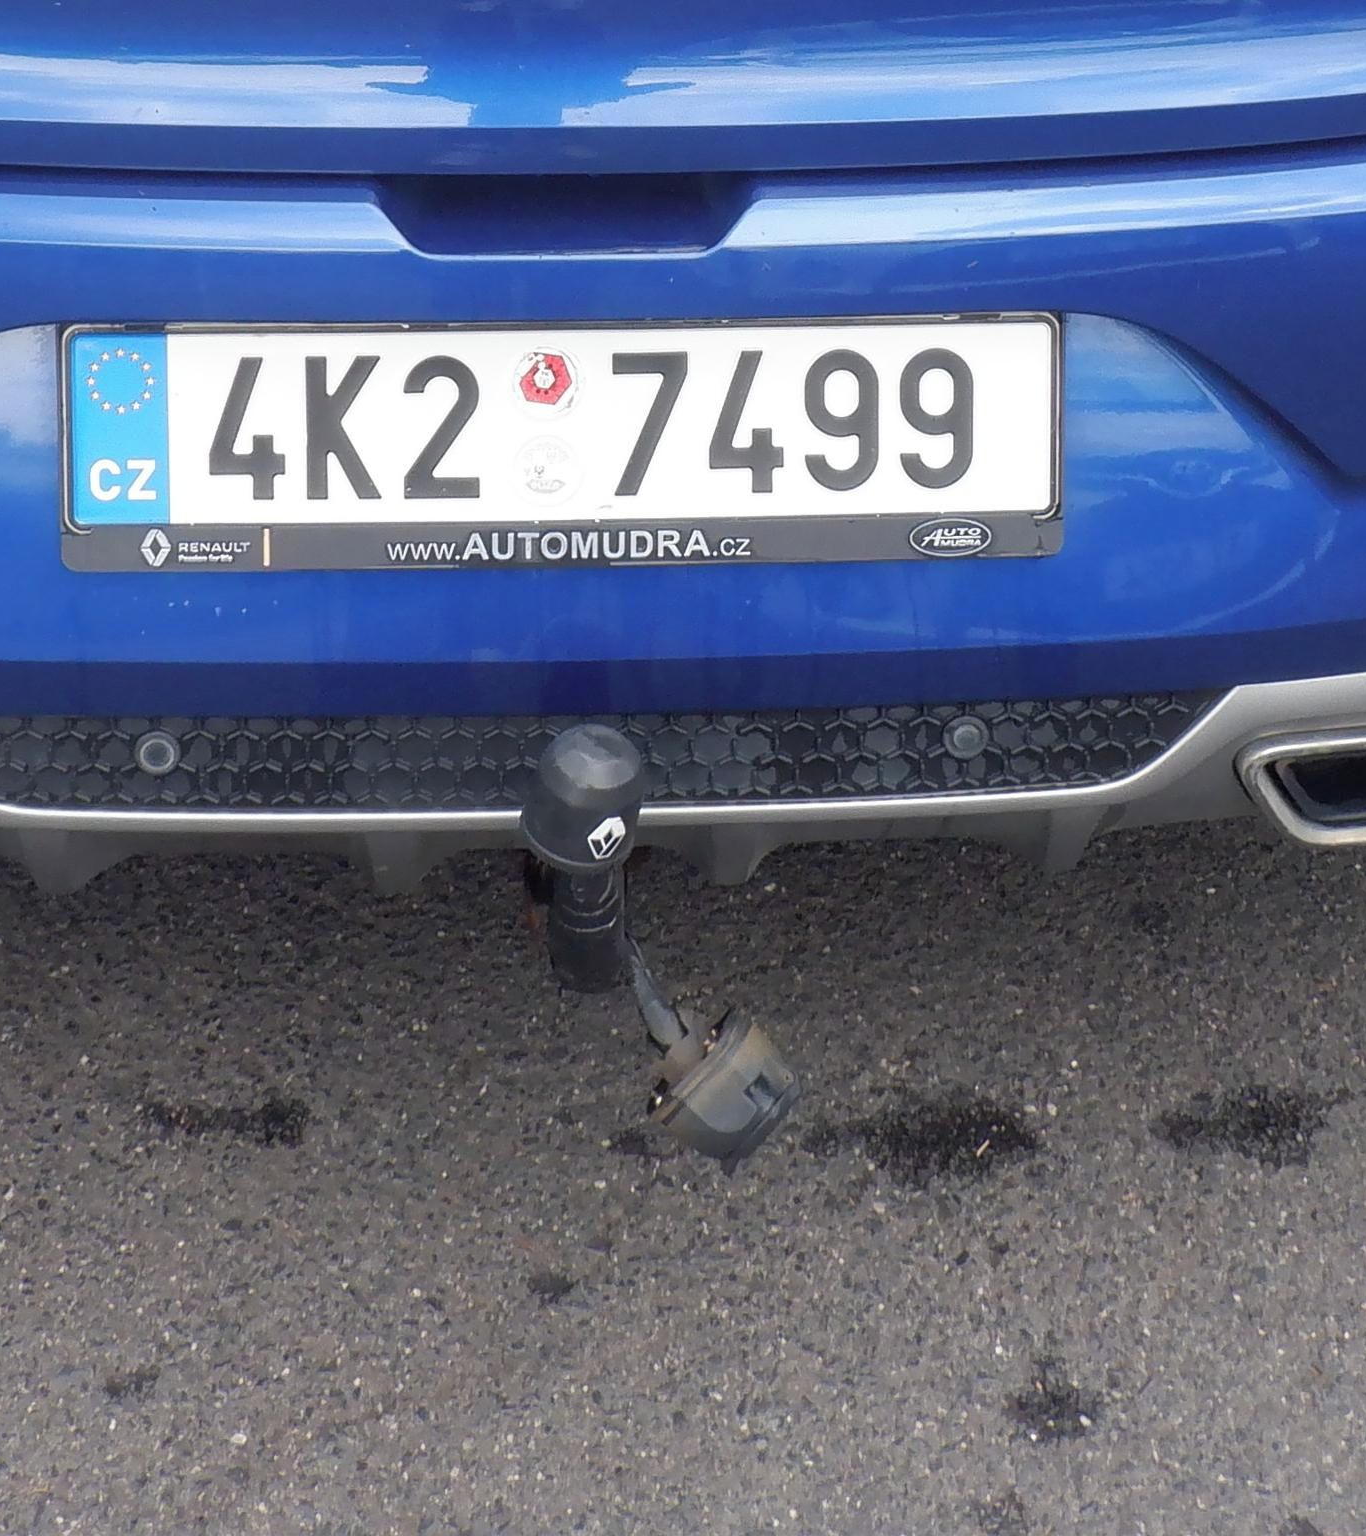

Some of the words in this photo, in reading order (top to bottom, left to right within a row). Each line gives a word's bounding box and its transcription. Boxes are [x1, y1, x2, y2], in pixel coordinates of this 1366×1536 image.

[208, 354, 481, 500] 4K2
[610, 348, 974, 497] 7499
[89, 458, 156, 501] CZ
[178, 541, 251, 553] RENAULT
[387, 530, 751, 561] www.AUTOMUDRA.cz
[921, 527, 982, 547] AUTO
